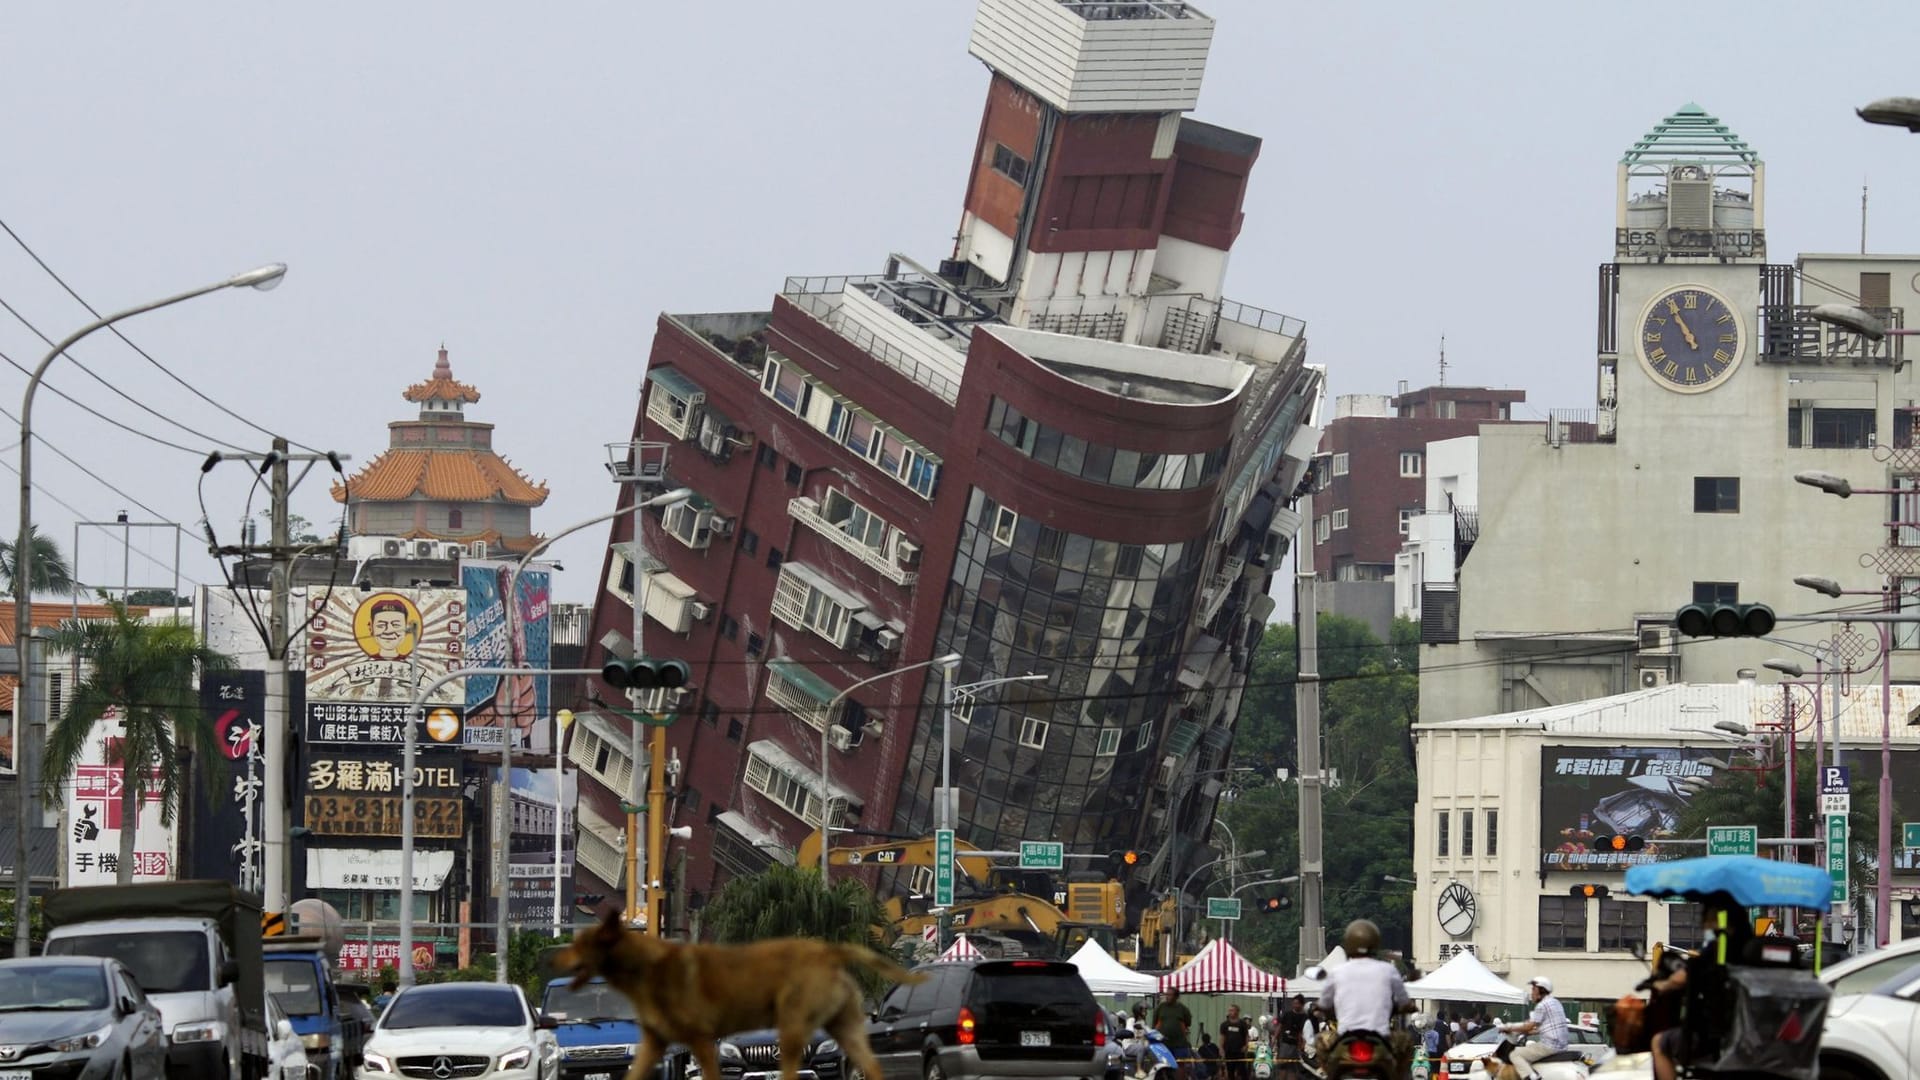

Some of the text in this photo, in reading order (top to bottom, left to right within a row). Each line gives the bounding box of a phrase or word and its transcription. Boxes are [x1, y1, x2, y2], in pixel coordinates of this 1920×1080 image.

[320, 724, 411, 741] (原住民一條街入
[1827, 768, 1840, 786] P
[309, 798, 459, 820] 03-831622
[1714, 830, 1750, 843] 福町路
[877, 851, 896, 862] CAT
[1054, 892, 1067, 904] AT
